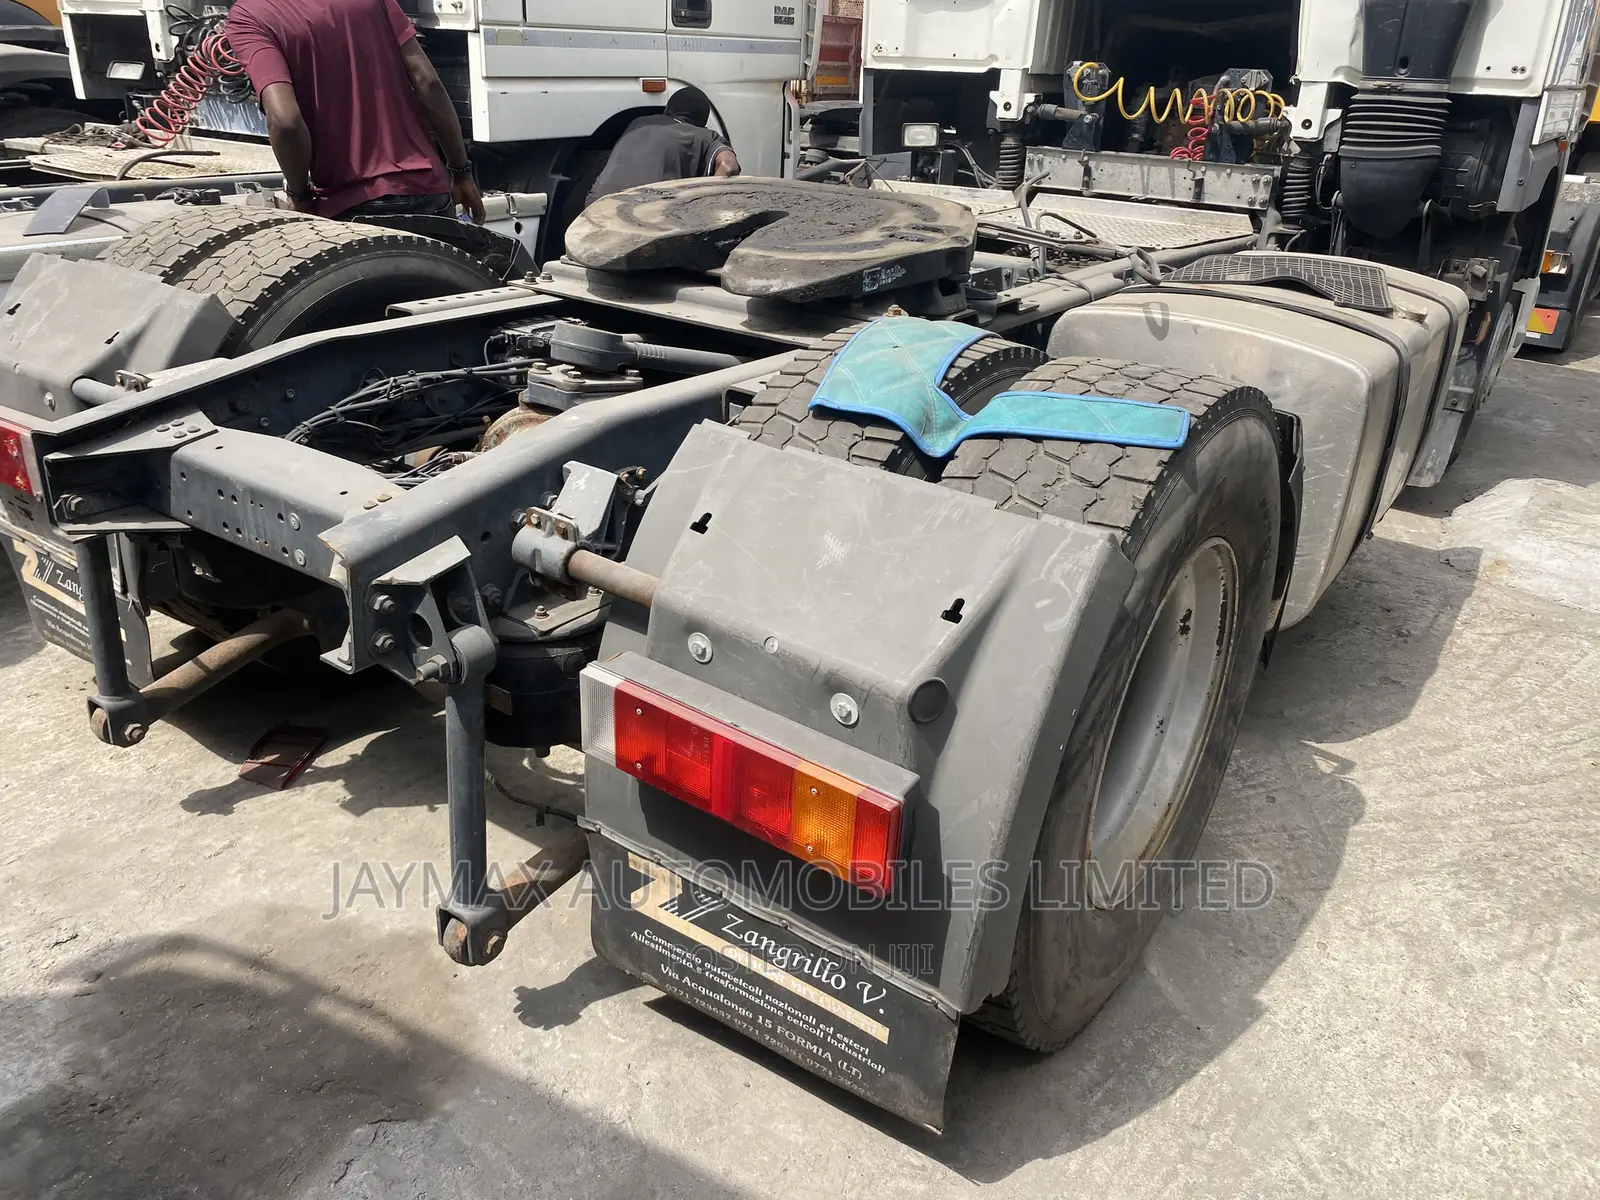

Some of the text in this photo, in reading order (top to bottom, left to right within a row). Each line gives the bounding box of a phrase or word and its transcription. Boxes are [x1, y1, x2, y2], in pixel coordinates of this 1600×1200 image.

[774, 5, 795, 15] DAF
[56, 569, 85, 604] Zang
[630, 930, 693, 968] Allestimento
[704, 970, 784, 1017] trasformazione
[786, 1014, 824, 1038] veicoli
[826, 1034, 885, 1074] industriali
[642, 928, 869, 1055] Commercio autoveicoli nazionali ed esteri
[720, 912, 886, 1014] Zangrillo V.
[660, 962, 862, 1079] Via Acqualonga 15 FORMIA (LT)
